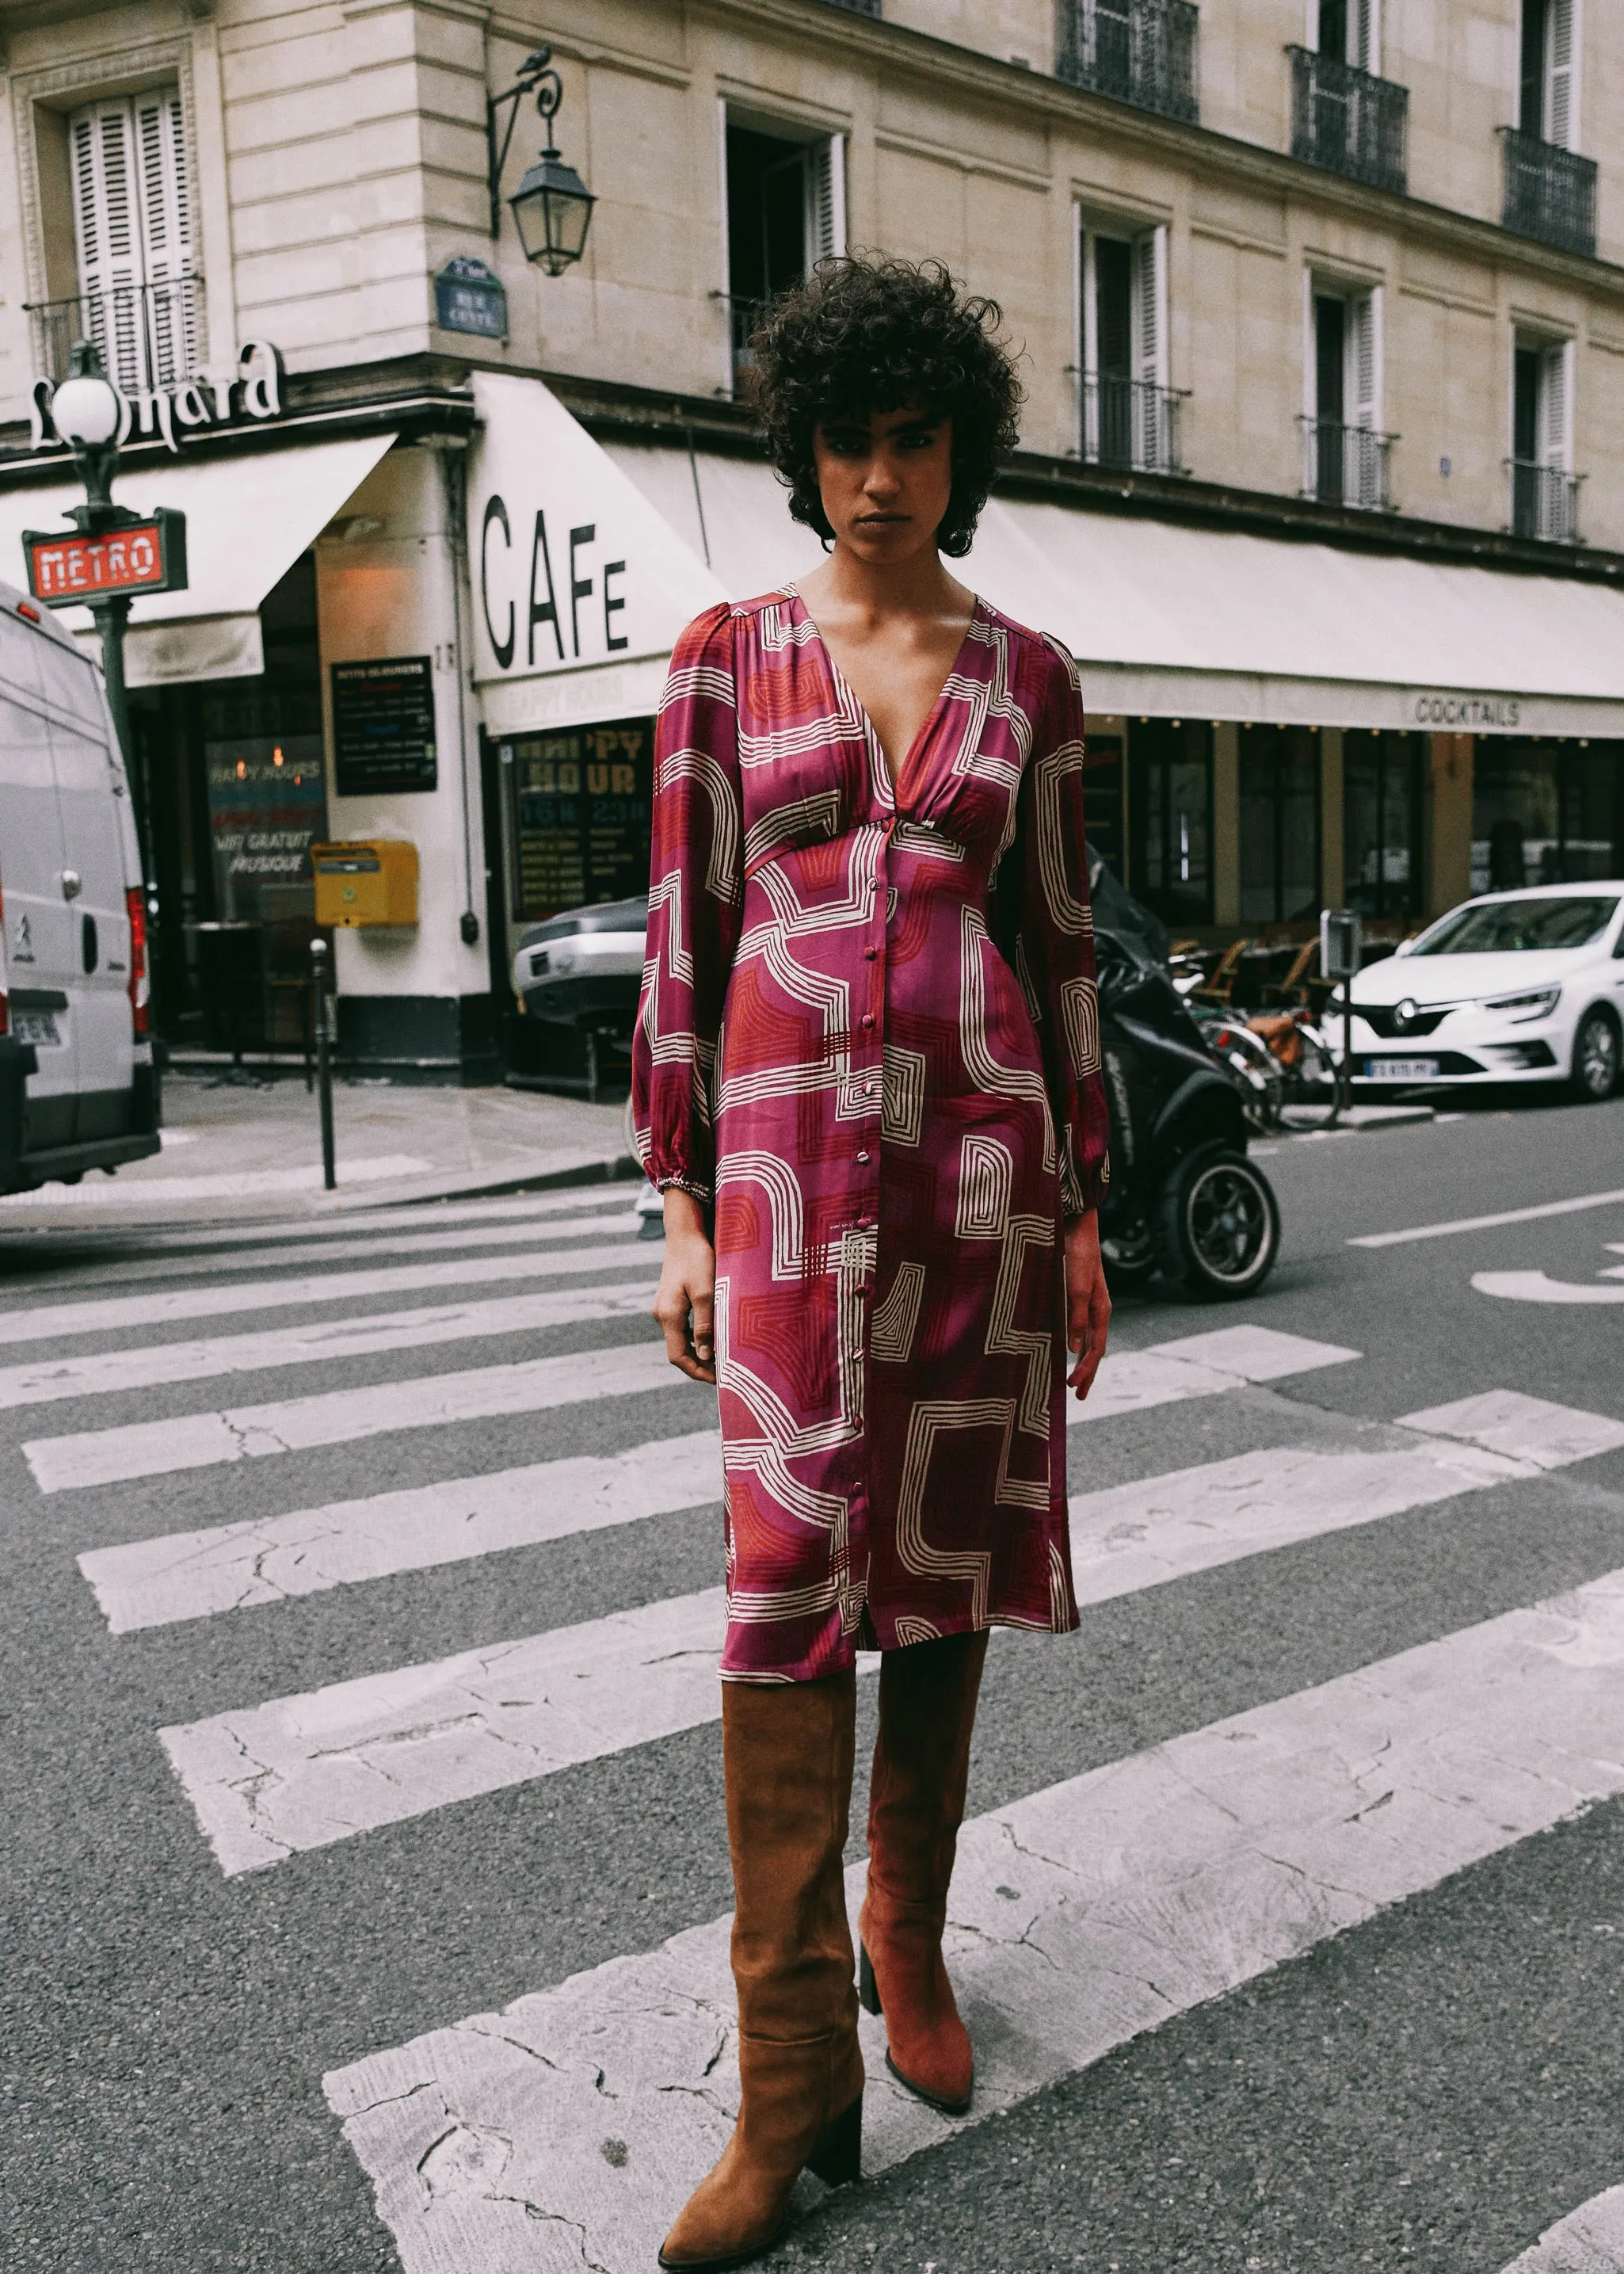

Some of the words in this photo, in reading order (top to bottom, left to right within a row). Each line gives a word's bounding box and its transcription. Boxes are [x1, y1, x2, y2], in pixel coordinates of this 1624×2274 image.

[40, 536, 154, 591] METRO
[482, 494, 629, 670] CAFE
[1414, 696, 1520, 727] COCKTAILS
[528, 762, 635, 795] HOUR
[246, 830, 314, 851] GRATUIT
